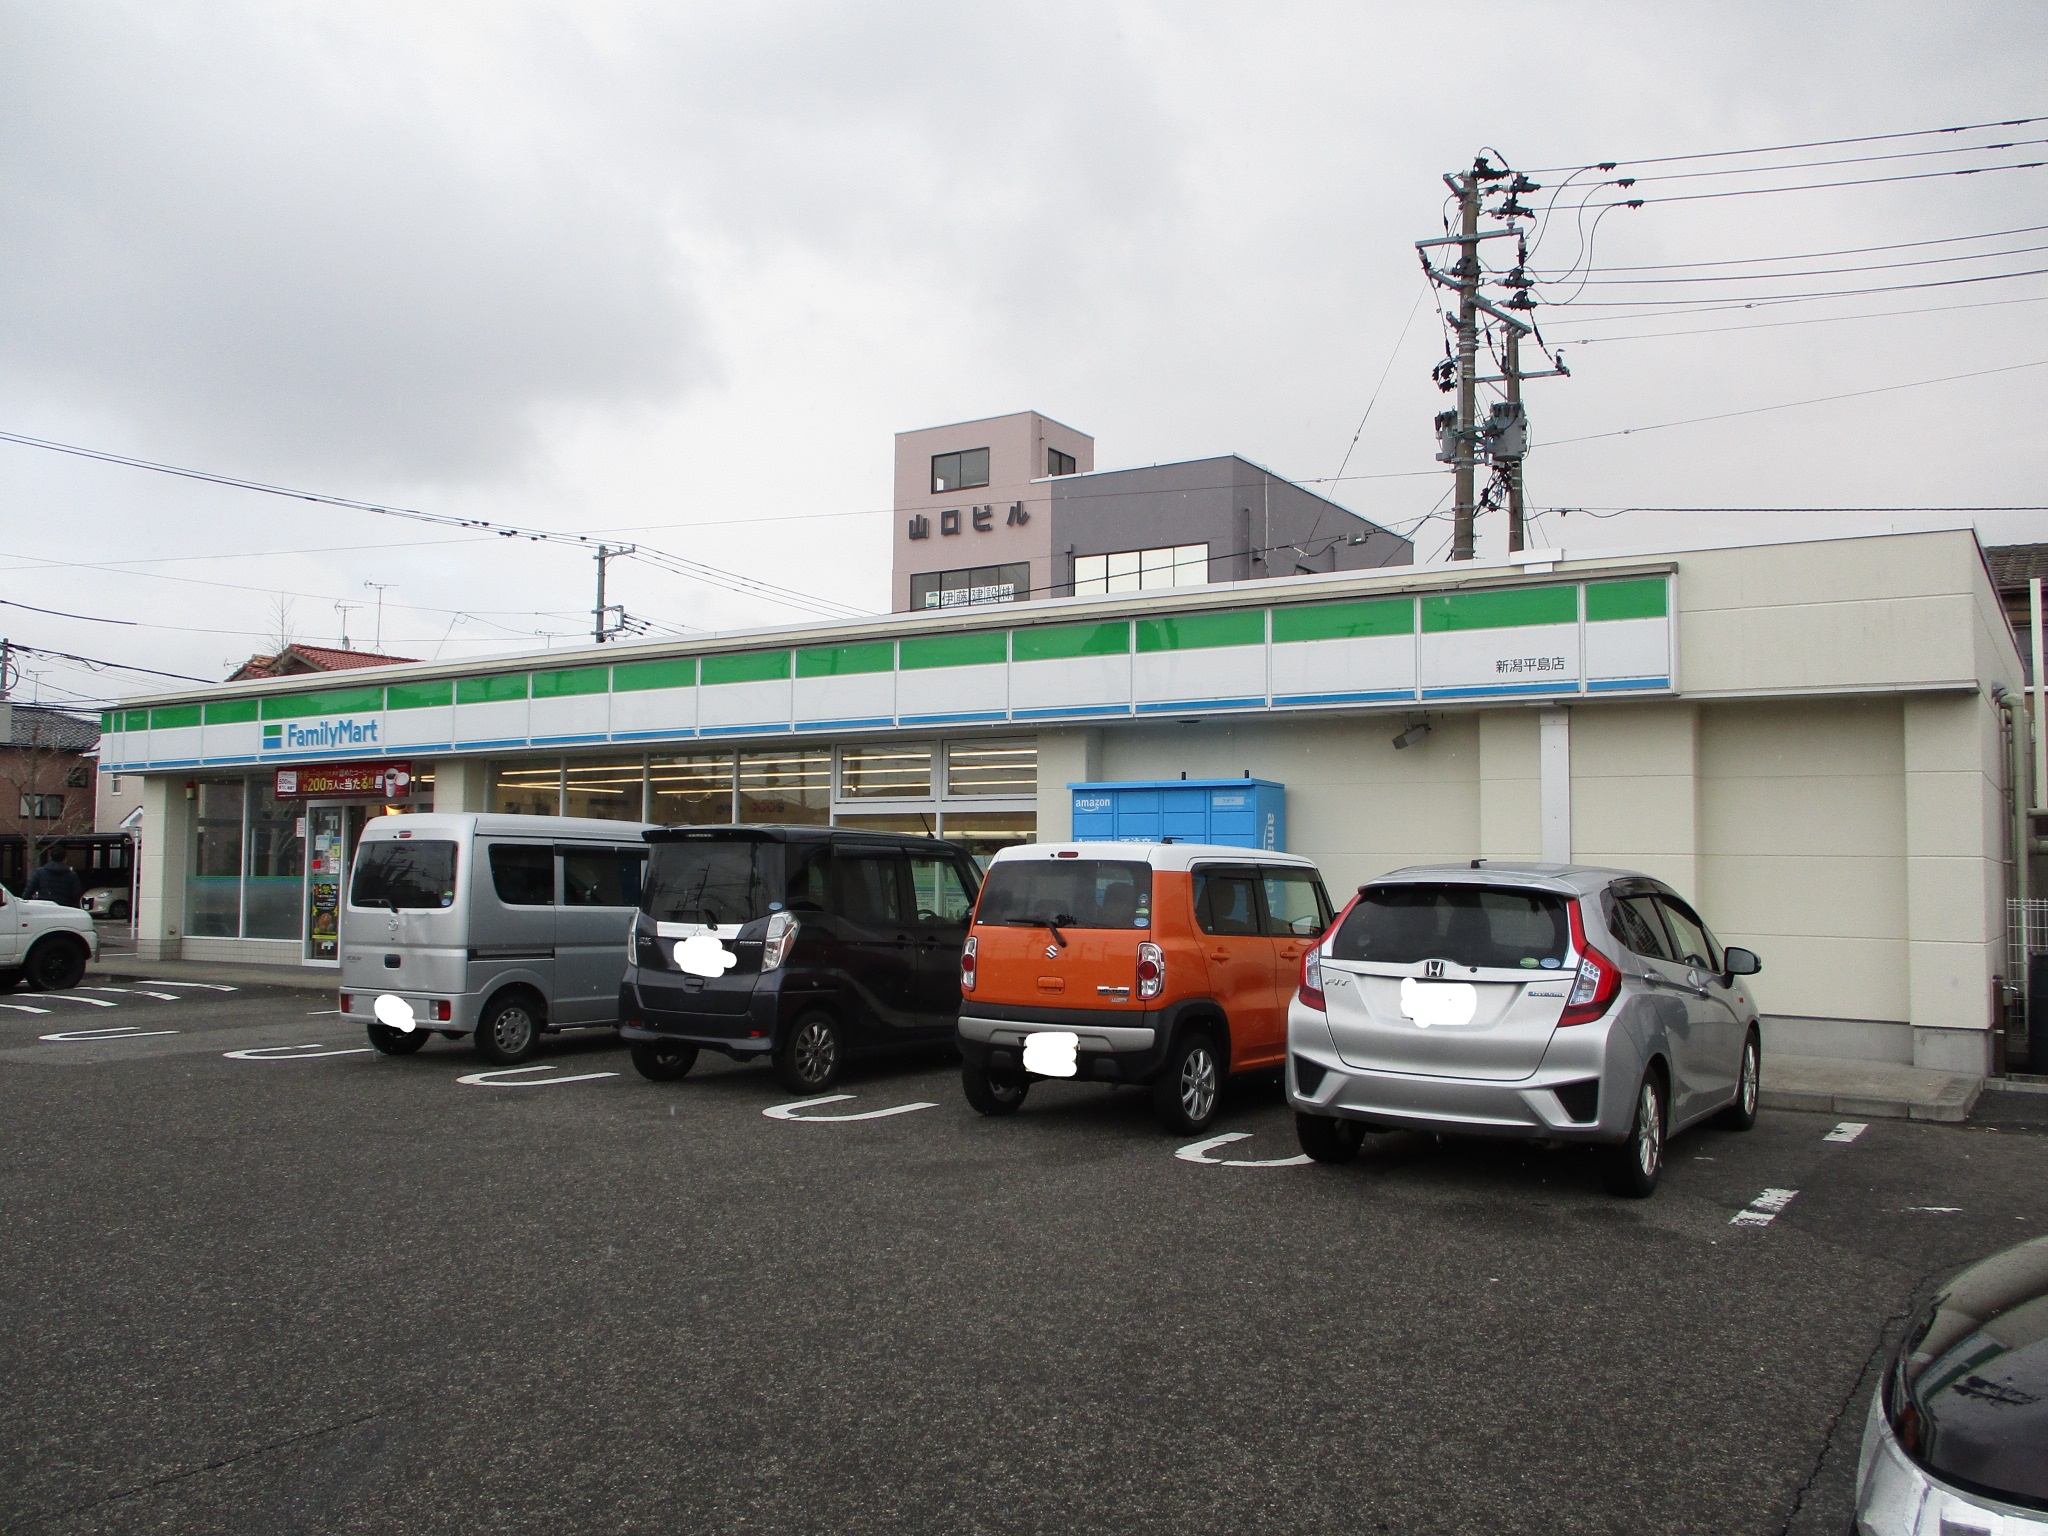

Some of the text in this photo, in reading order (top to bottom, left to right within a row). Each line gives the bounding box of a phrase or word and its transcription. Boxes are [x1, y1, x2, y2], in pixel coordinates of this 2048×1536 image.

[908, 500, 1030, 540] 山口ビル
[1495, 656, 1565, 674] 新潟平島店
[288, 719, 378, 747] FamilyMart
[1075, 798, 1111, 807] amazon
